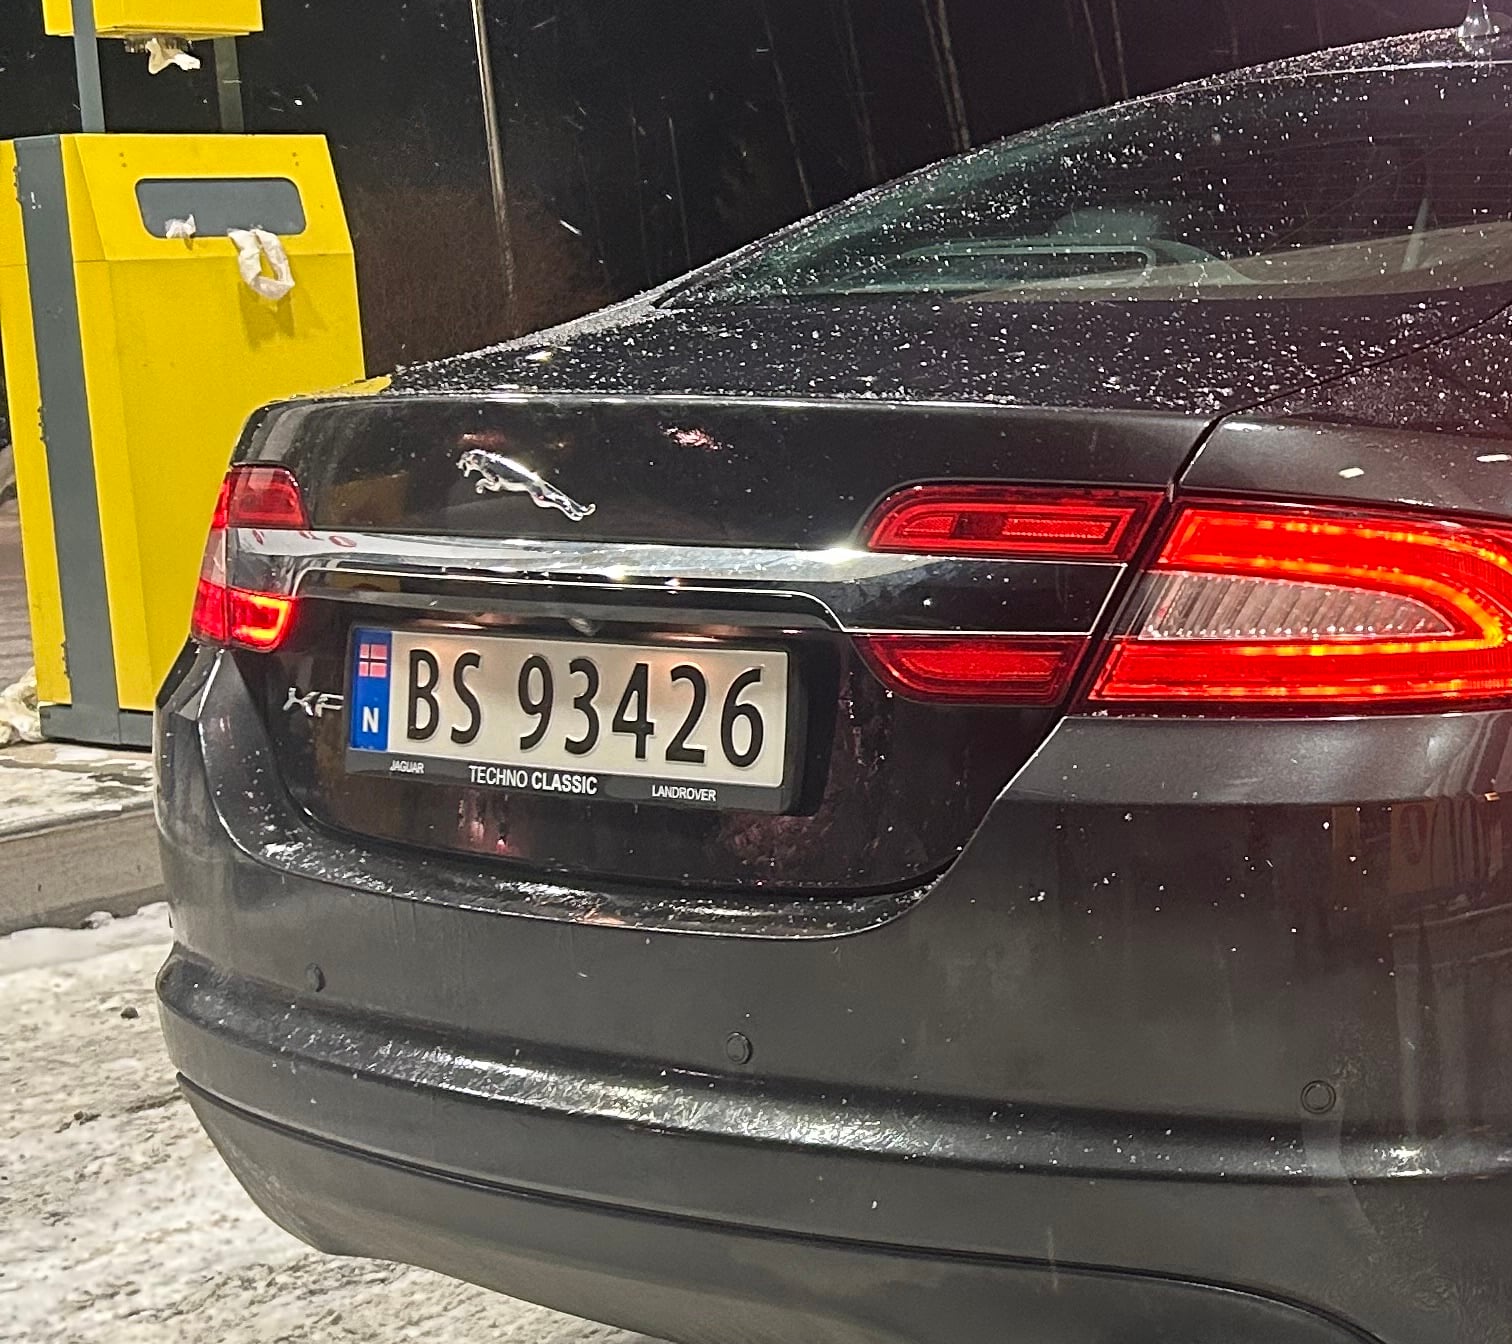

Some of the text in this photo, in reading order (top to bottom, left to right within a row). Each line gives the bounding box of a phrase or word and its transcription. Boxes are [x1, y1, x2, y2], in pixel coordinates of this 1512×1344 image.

[282, 687, 344, 718] XF
[406, 649, 765, 768] BS 93426
[362, 706, 379, 733] N
[389, 759, 425, 774] JAGUAR
[468, 764, 598, 795] TECHNO CLASSIC
[651, 784, 717, 802] LANDROVER
